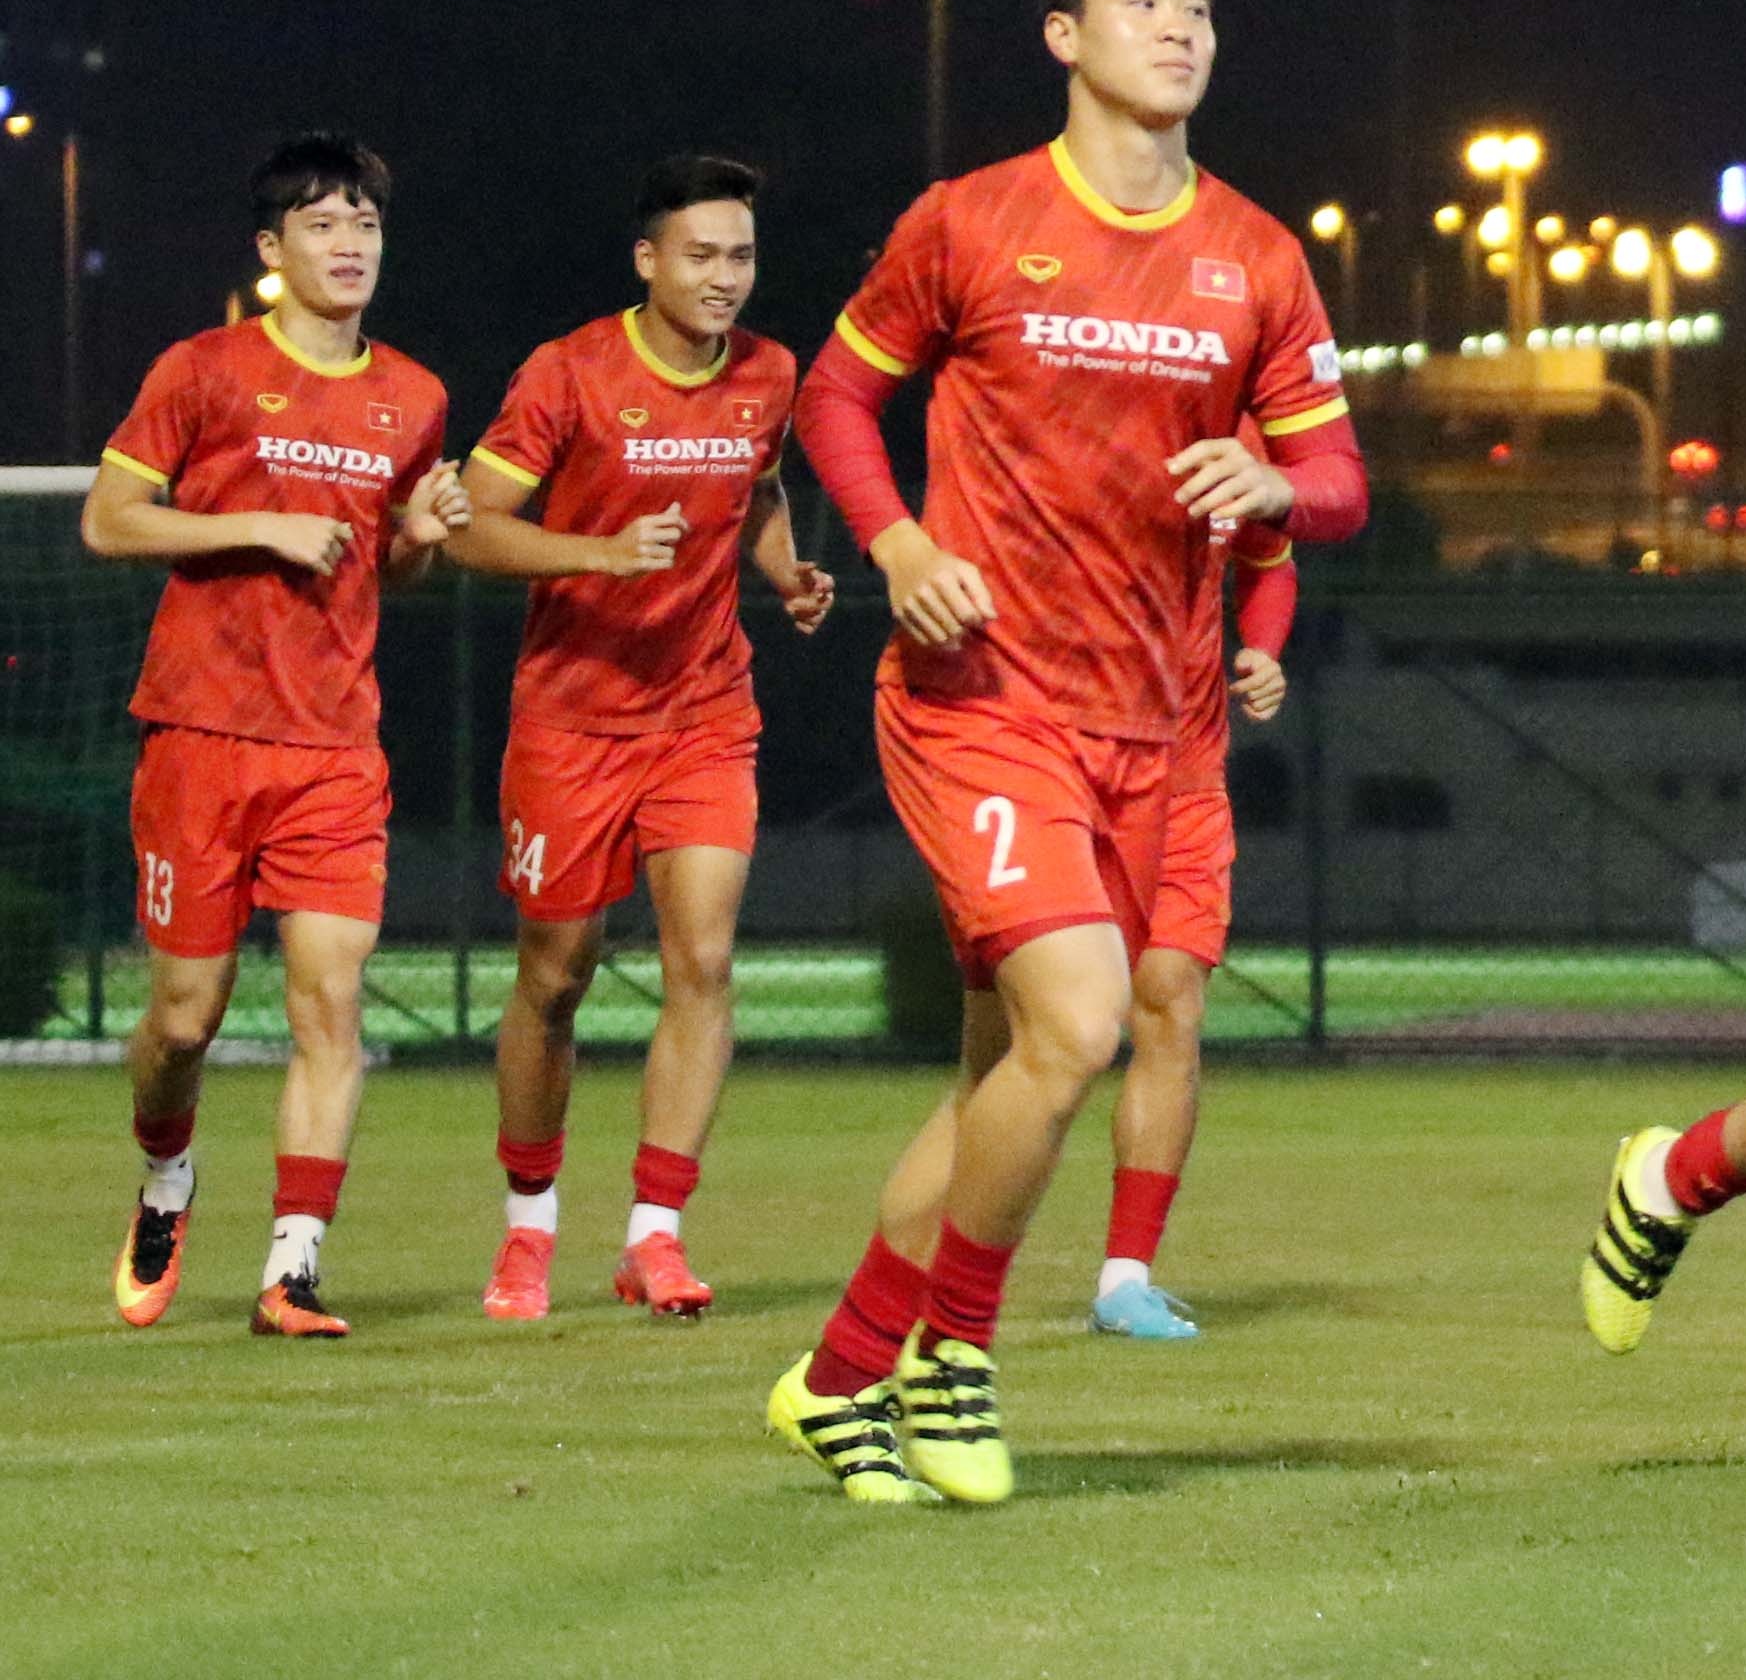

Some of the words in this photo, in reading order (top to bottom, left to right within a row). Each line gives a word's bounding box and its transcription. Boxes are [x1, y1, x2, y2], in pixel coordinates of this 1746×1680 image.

[1020, 313, 1231, 365] HONDA
[1037, 350, 1070, 368] The
[1073, 353, 1127, 374] Power
[1128, 358, 1149, 374] of
[1150, 360, 1212, 384] Dreams
[256, 435, 394, 479] HONDA
[623, 437, 754, 460] HONDA
[629, 464, 650, 474] The
[654, 464, 691, 474] Power
[694, 463, 708, 474] of
[266, 462, 286, 475] The
[290, 467, 322, 481] Power
[325, 470, 338, 482] of
[340, 474, 382, 490] Dreams
[509, 818, 545, 895] 34
[974, 796, 1026, 889] 2
[145, 852, 175, 925] 13
